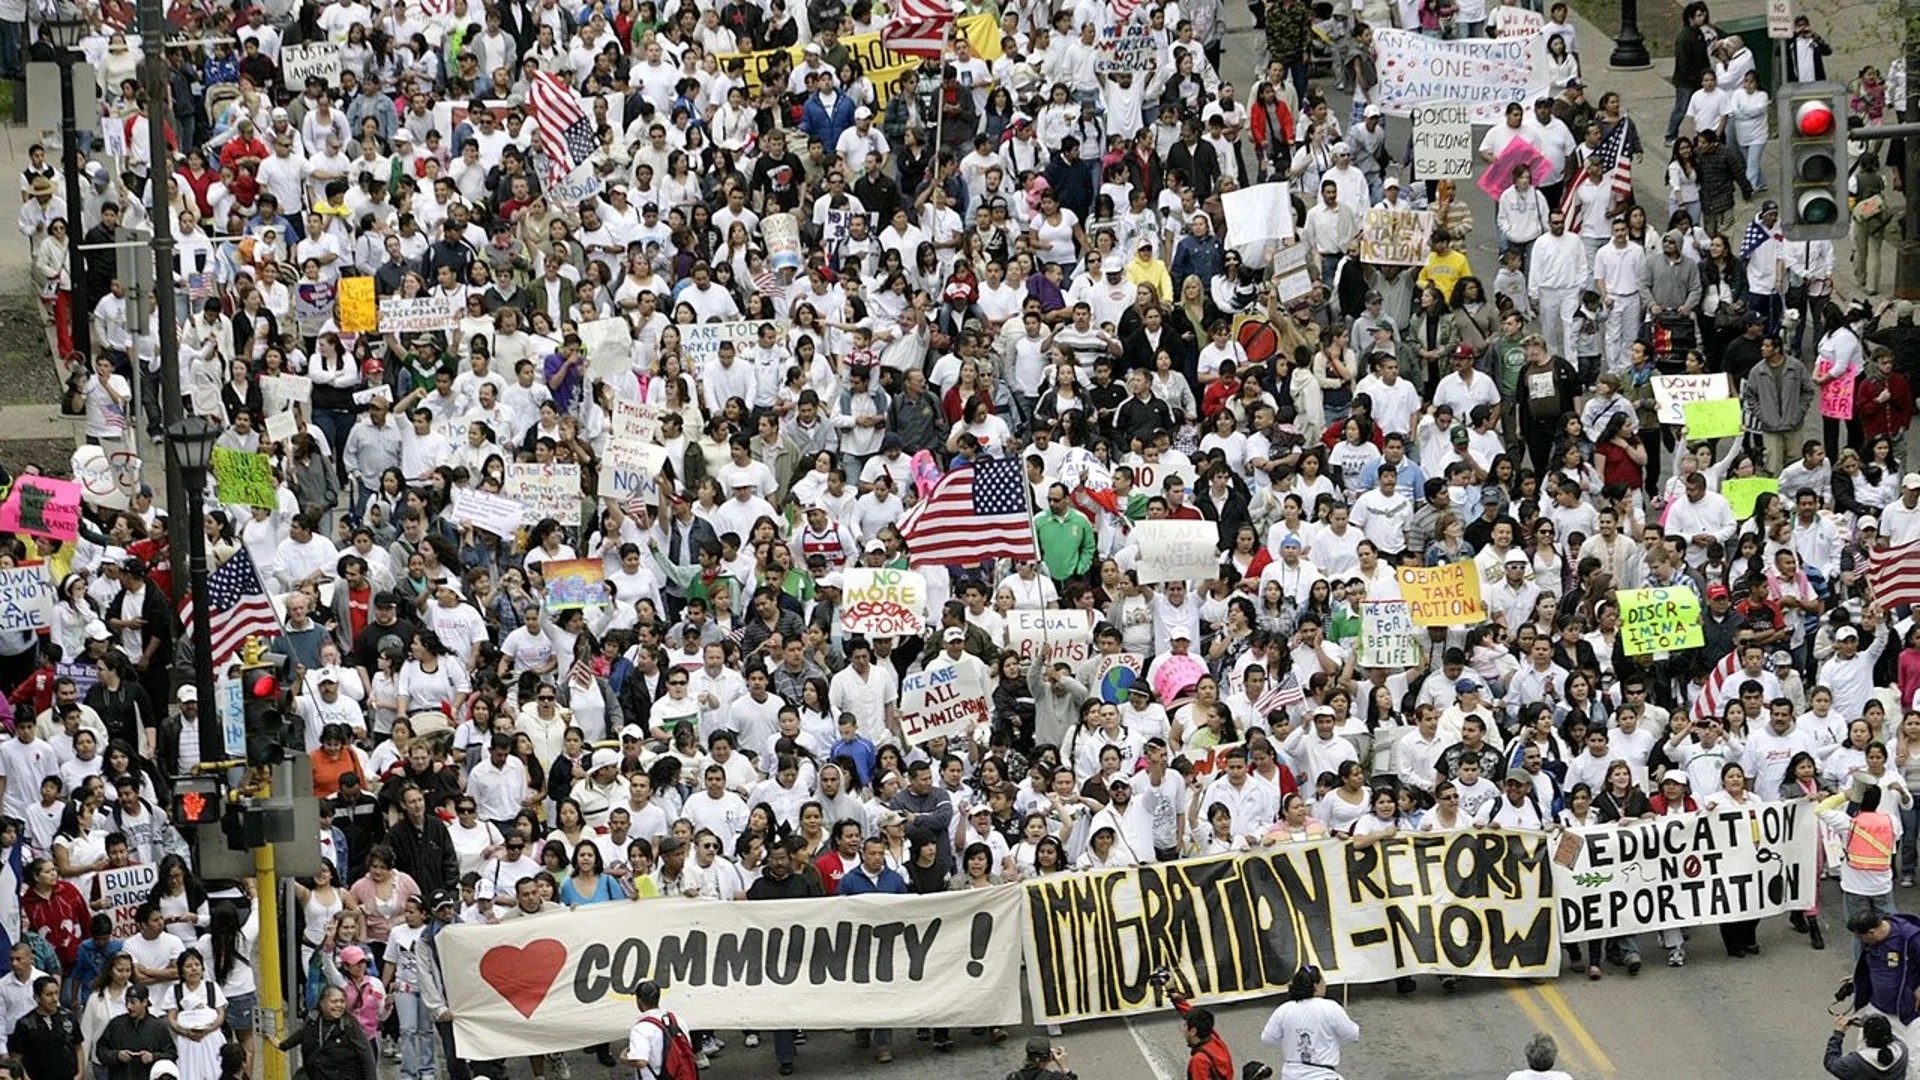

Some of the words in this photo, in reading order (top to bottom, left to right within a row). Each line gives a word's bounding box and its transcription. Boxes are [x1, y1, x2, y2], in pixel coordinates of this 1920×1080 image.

[1377, 30, 1418, 51] ANY
[1499, 42, 1522, 60] TO
[1113, 50, 1143, 63] NOT
[1430, 58, 1474, 78] ONE
[1377, 78, 1395, 97] IS
[1404, 82, 1431, 98] AN
[1442, 84, 1501, 102] INJURY
[1509, 86, 1527, 102] TO
[1410, 106, 1469, 127] BOYCOTT
[1416, 158, 1437, 175] SB
[1443, 158, 1473, 176] 1070
[1360, 237, 1424, 263] ACTION
[680, 326, 719, 341] ARE
[1660, 377, 1712, 390] DOWN
[1668, 391, 1707, 402] WITH
[872, 569, 903, 587] NO
[1401, 564, 1466, 586] OBAMA
[15, 581, 53, 600] NOT
[846, 585, 916, 605] MORE
[1421, 581, 1465, 600] TAKE
[1636, 588, 1670, 601] NO
[4, 601, 22, 616] A
[1365, 602, 1380, 616] WE
[1410, 597, 1476, 618] ACTION
[1019, 612, 1079, 630] EQUAL
[1376, 616, 1401, 634] FOR
[1367, 633, 1414, 649] BETTER
[1634, 635, 1687, 653] TION
[1376, 650, 1407, 665] LIFE
[904, 675, 926, 692] WE
[929, 665, 958, 686] ARE
[924, 683, 961, 708] ALL
[1585, 803, 1798, 868] EDUCATION
[1345, 833, 1554, 903] REFORM
[1660, 852, 1723, 882] NOT
[105, 867, 154, 891] BUILD
[1559, 863, 1800, 934] DEPORTATION
[1027, 847, 1339, 1017] IMMIGRATION
[573, 914, 943, 1003] COMMUNITY
